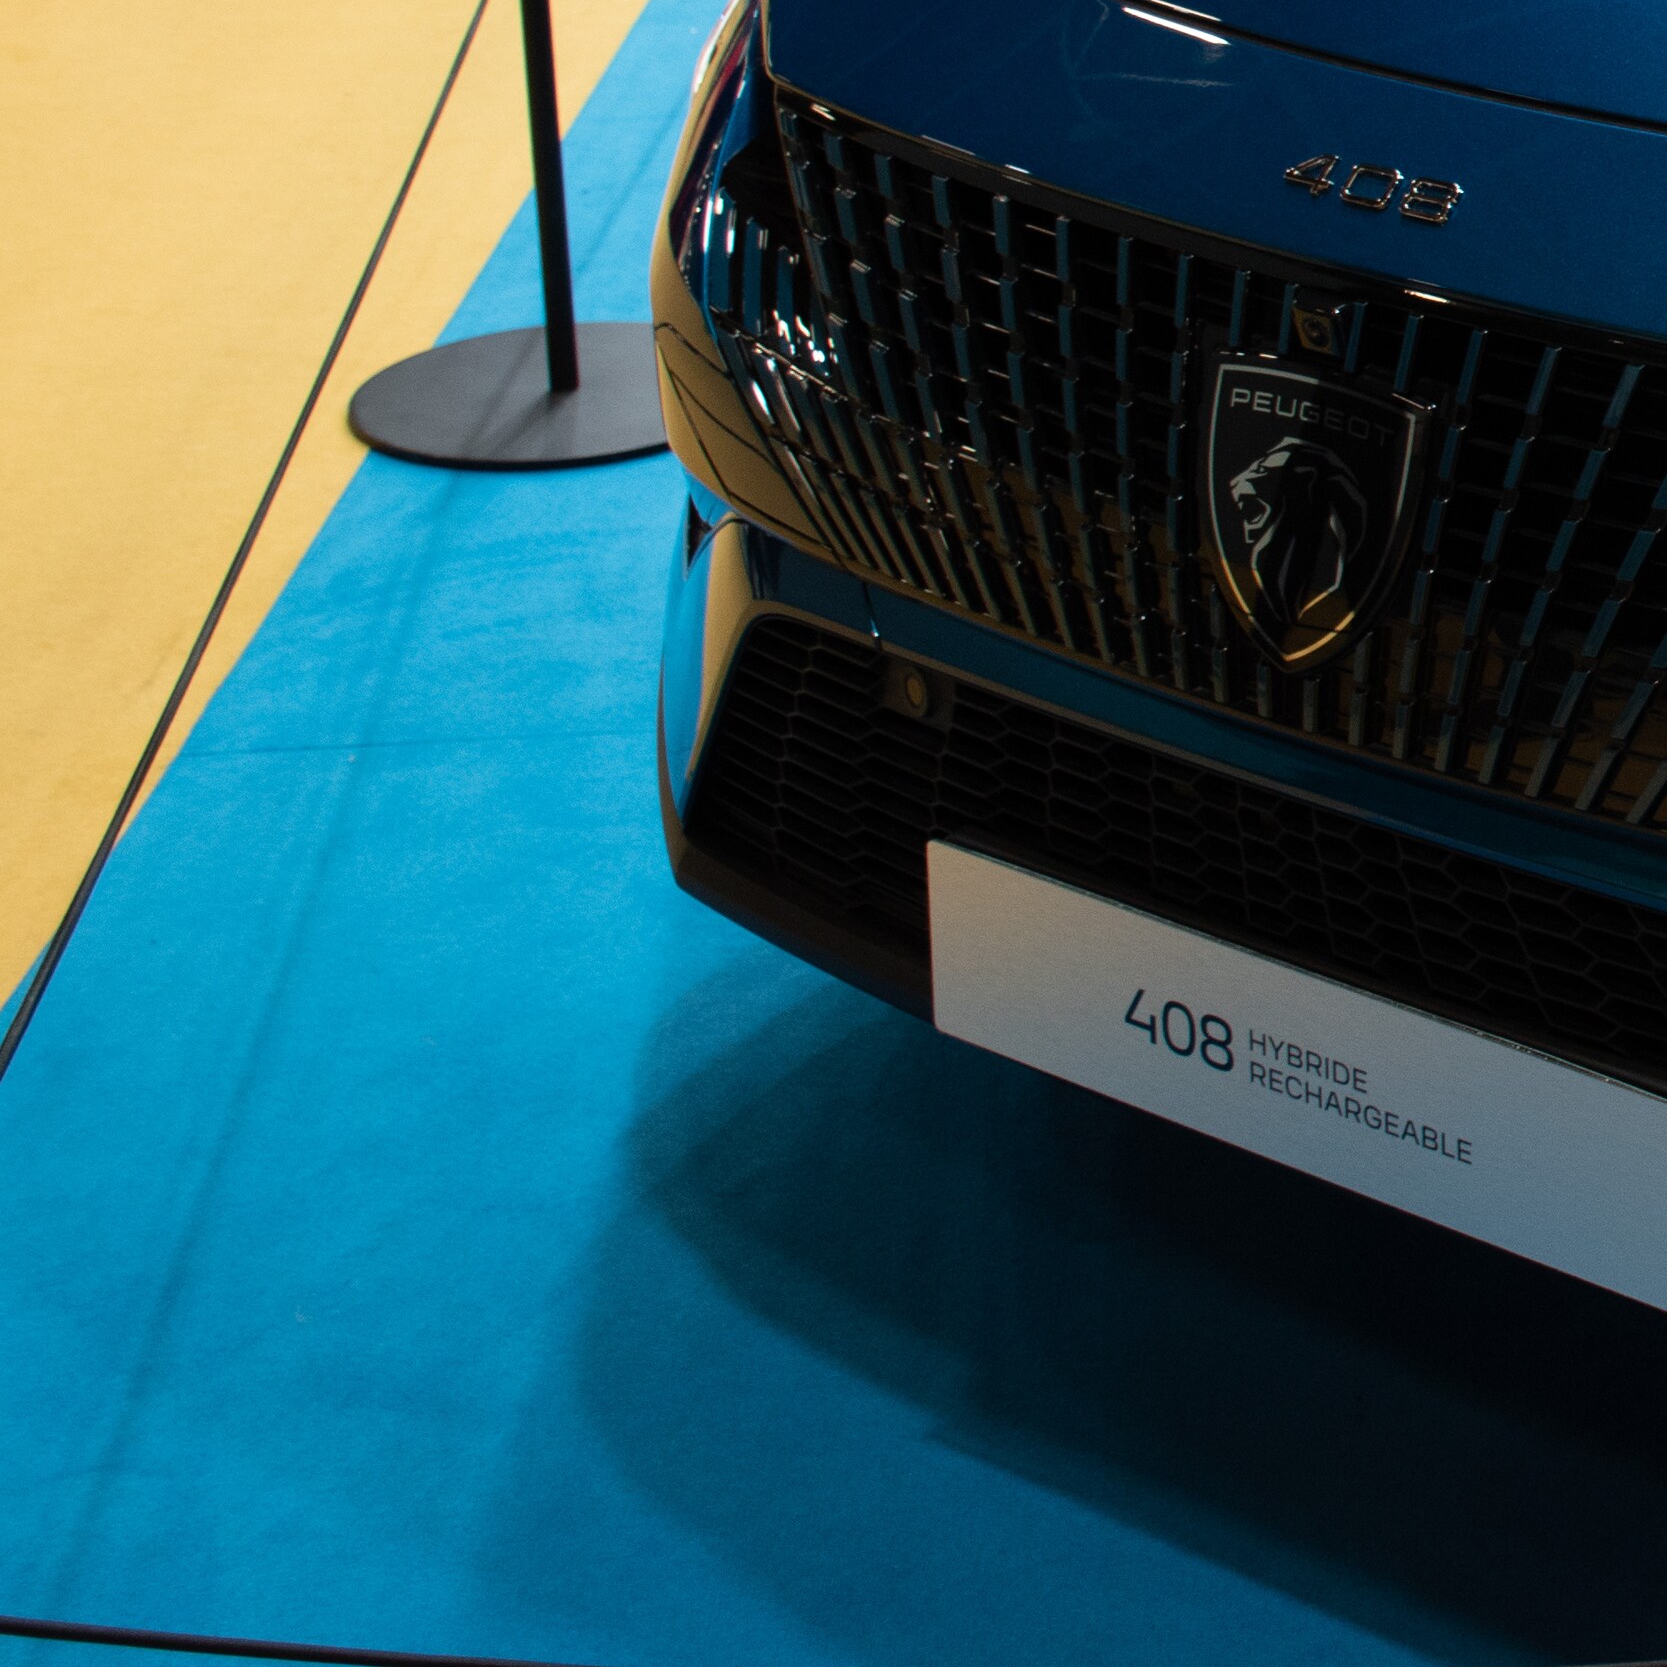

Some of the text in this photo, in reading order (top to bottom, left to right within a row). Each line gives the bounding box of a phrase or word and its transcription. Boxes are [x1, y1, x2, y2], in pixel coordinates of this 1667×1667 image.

[1284, 154, 1465, 227] 408
[1229, 387, 1395, 448] PEUGEOT
[1124, 988, 1368, 1094] 408 HYBRIDE
[1249, 1061, 1473, 1165] RECHARGEABLE
